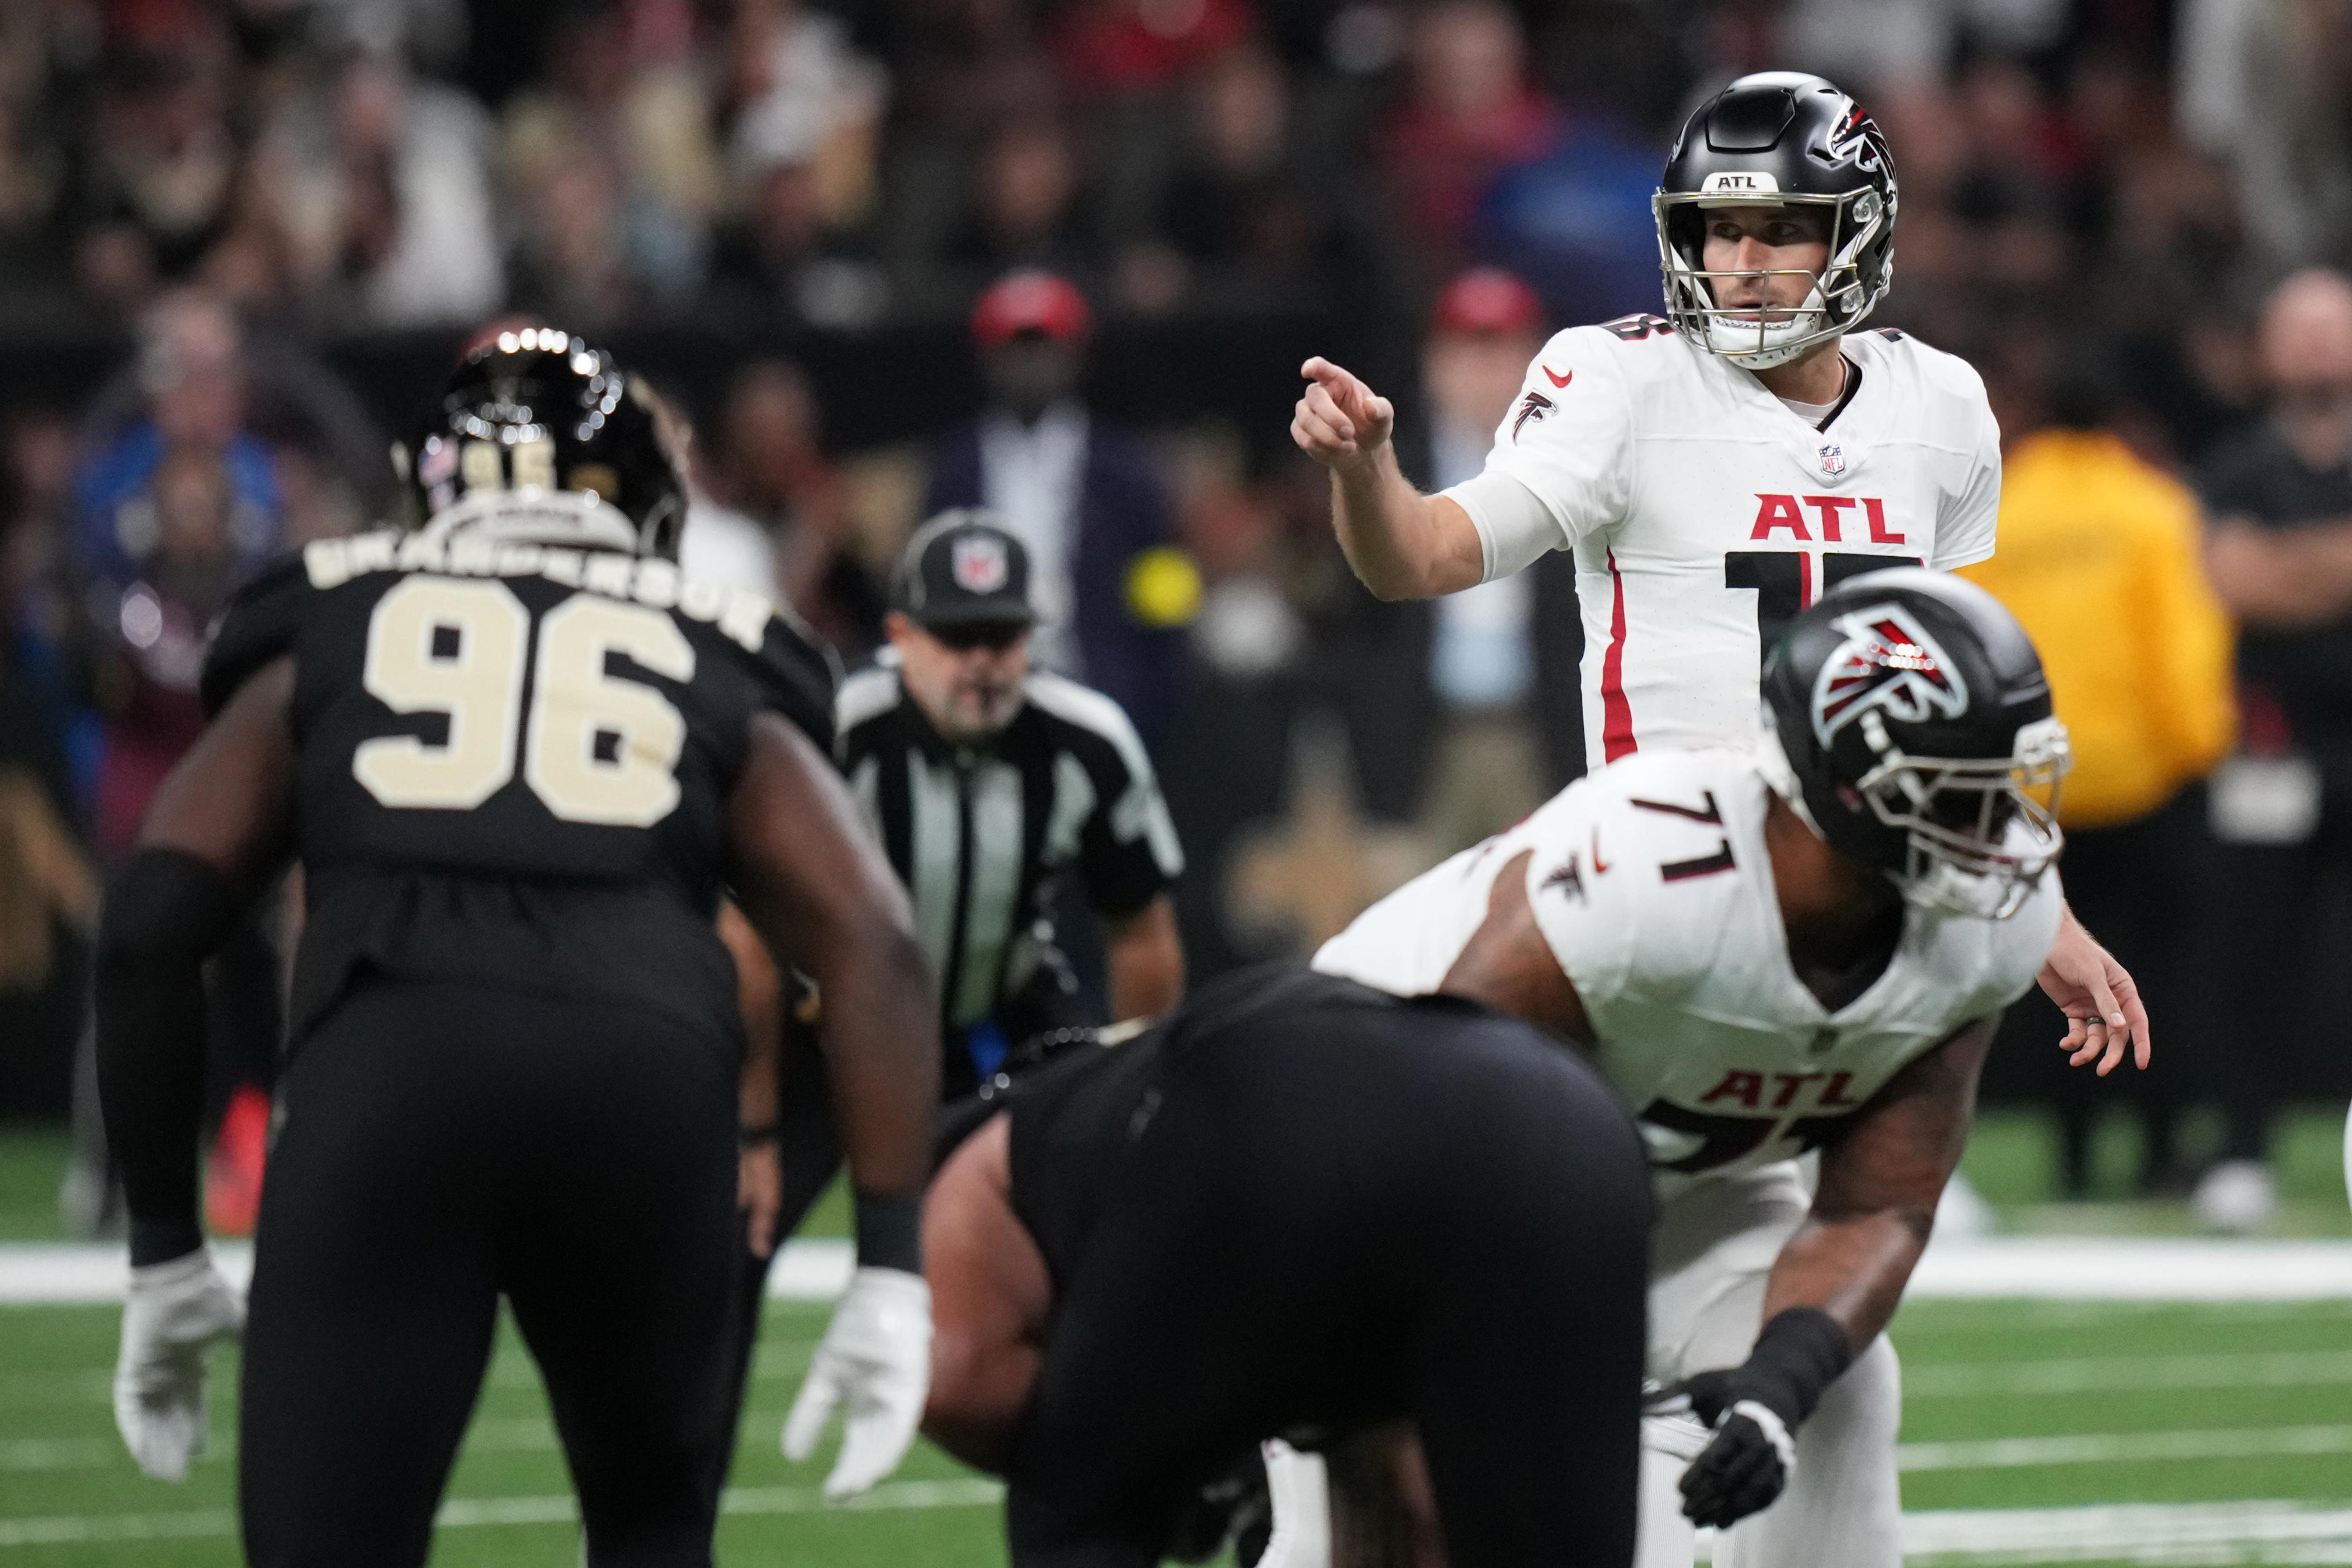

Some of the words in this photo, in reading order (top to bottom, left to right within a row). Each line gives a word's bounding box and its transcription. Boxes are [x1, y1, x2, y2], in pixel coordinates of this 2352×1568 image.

[1717, 176, 1757, 188] ATL
[1824, 457, 1843, 471] NFL
[1750, 494, 1905, 544] ATL
[353, 575, 695, 828] 96
[1629, 789, 1736, 883] 71
[1700, 1070, 1859, 1107] ATL
